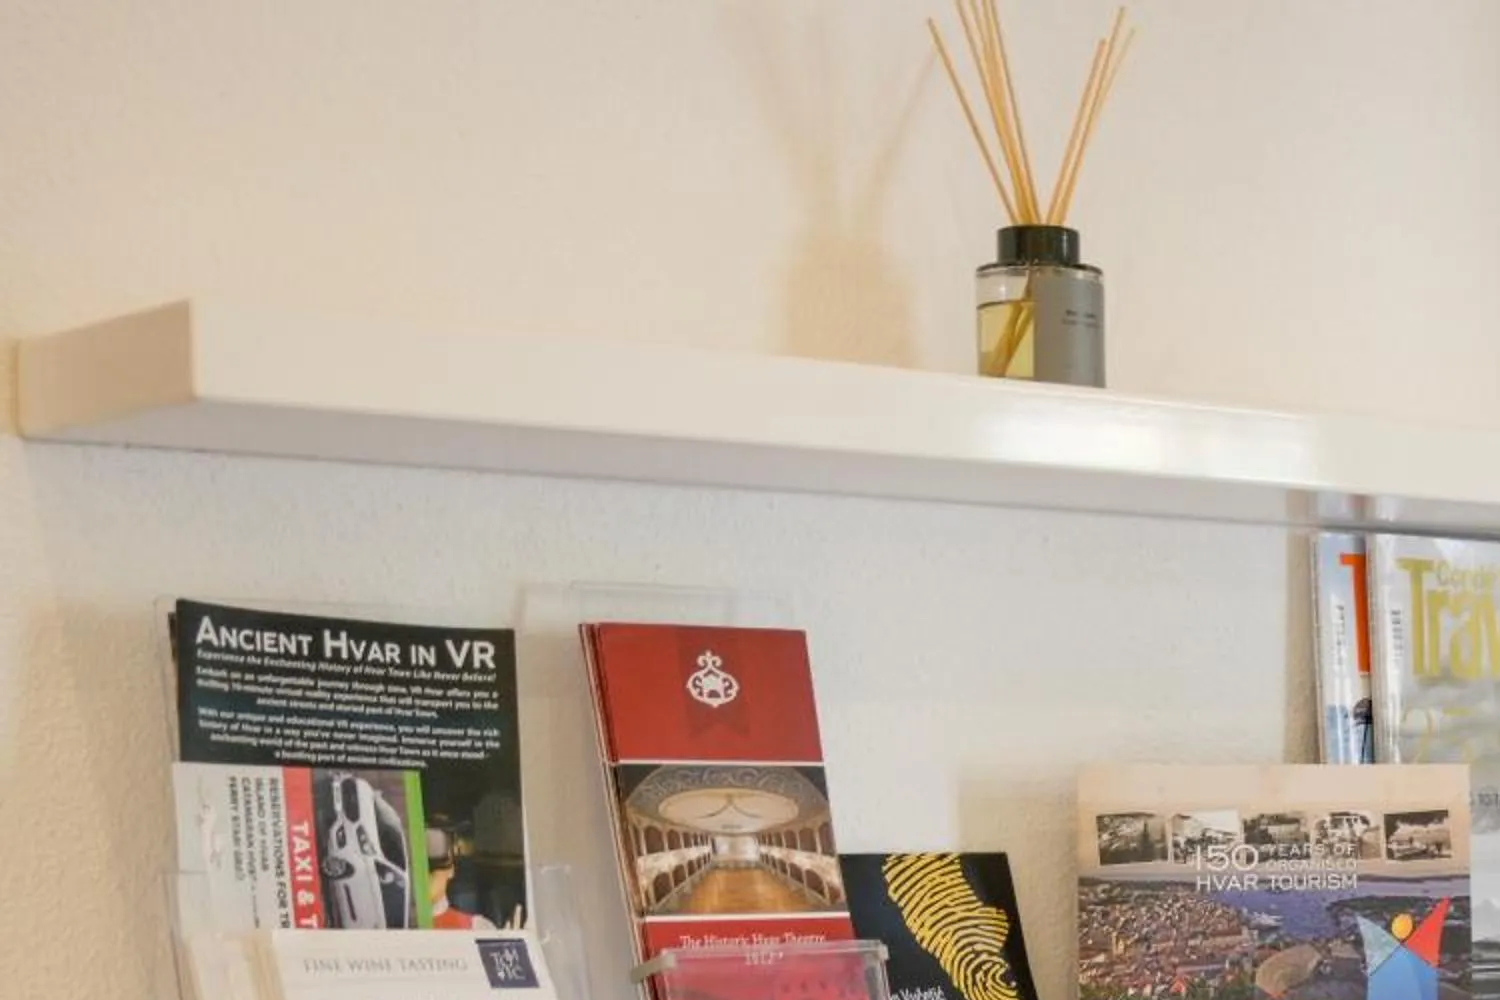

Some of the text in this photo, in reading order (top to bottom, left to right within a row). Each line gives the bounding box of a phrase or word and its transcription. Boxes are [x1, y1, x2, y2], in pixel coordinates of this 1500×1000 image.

[196, 615, 497, 669] ANCIENT HVAR IN VR
[269, 777, 285, 879] RESERVATIONS
[277, 881, 288, 909] FOR
[291, 819, 313, 881] TAXI
[1195, 842, 1358, 872] 150 YEARS OF
[296, 890, 315, 905] &
[1195, 872, 1359, 893] HVAR TOURISM
[303, 956, 469, 974] FINE WINE TASTING
